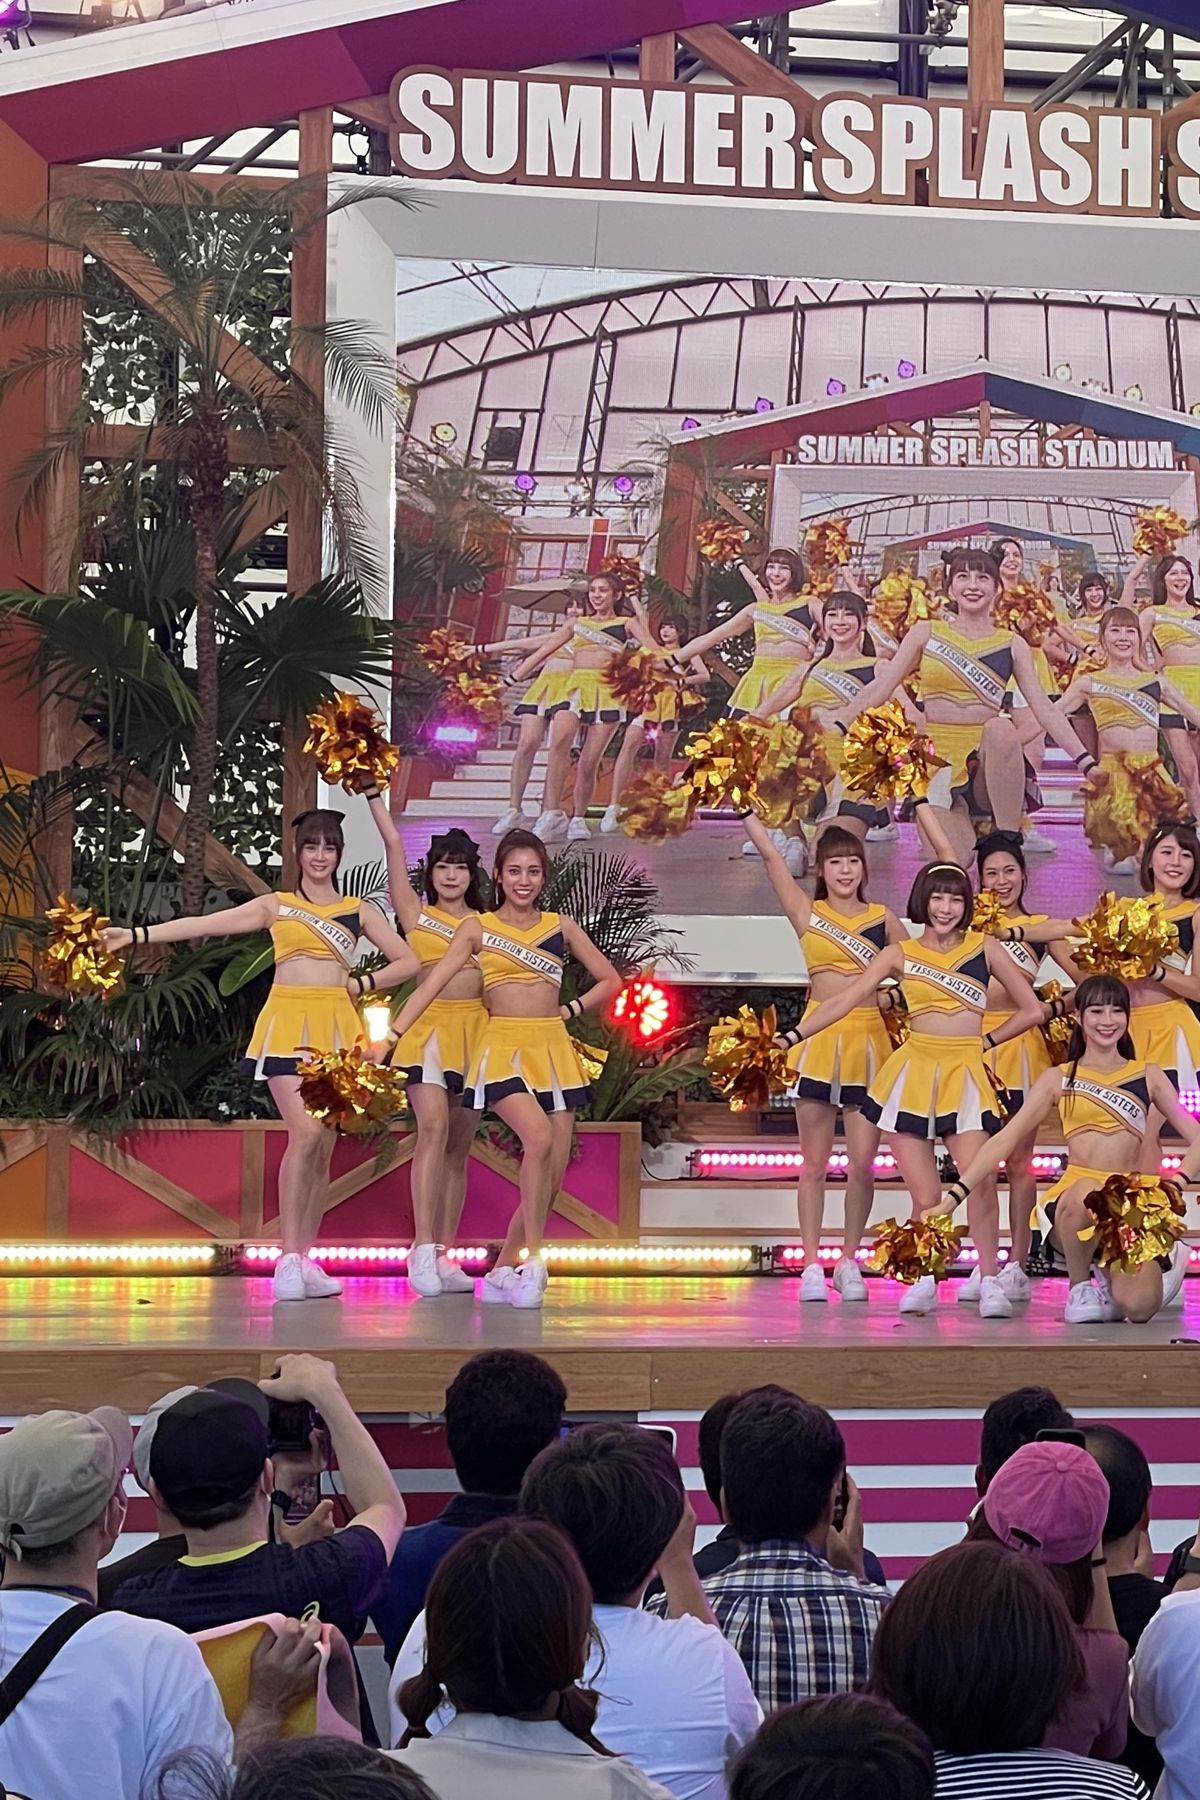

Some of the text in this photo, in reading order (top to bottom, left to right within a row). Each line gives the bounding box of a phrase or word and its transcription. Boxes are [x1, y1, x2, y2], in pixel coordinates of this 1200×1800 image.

[398, 72, 797, 190] SUMMER
[820, 98, 1153, 209] SPLASH
[798, 435, 1174, 469] SUMMER SPLASH STADIUM
[935, 644, 1000, 697] PASSION SISTERS
[319, 921, 352, 950] SISTERS
[815, 919, 848, 942] PASSION
[486, 935, 558, 975] PASSION SISTERS
[910, 963, 982, 1002] PASSION SISTERS
[1102, 1090, 1141, 1119] SISTERS
